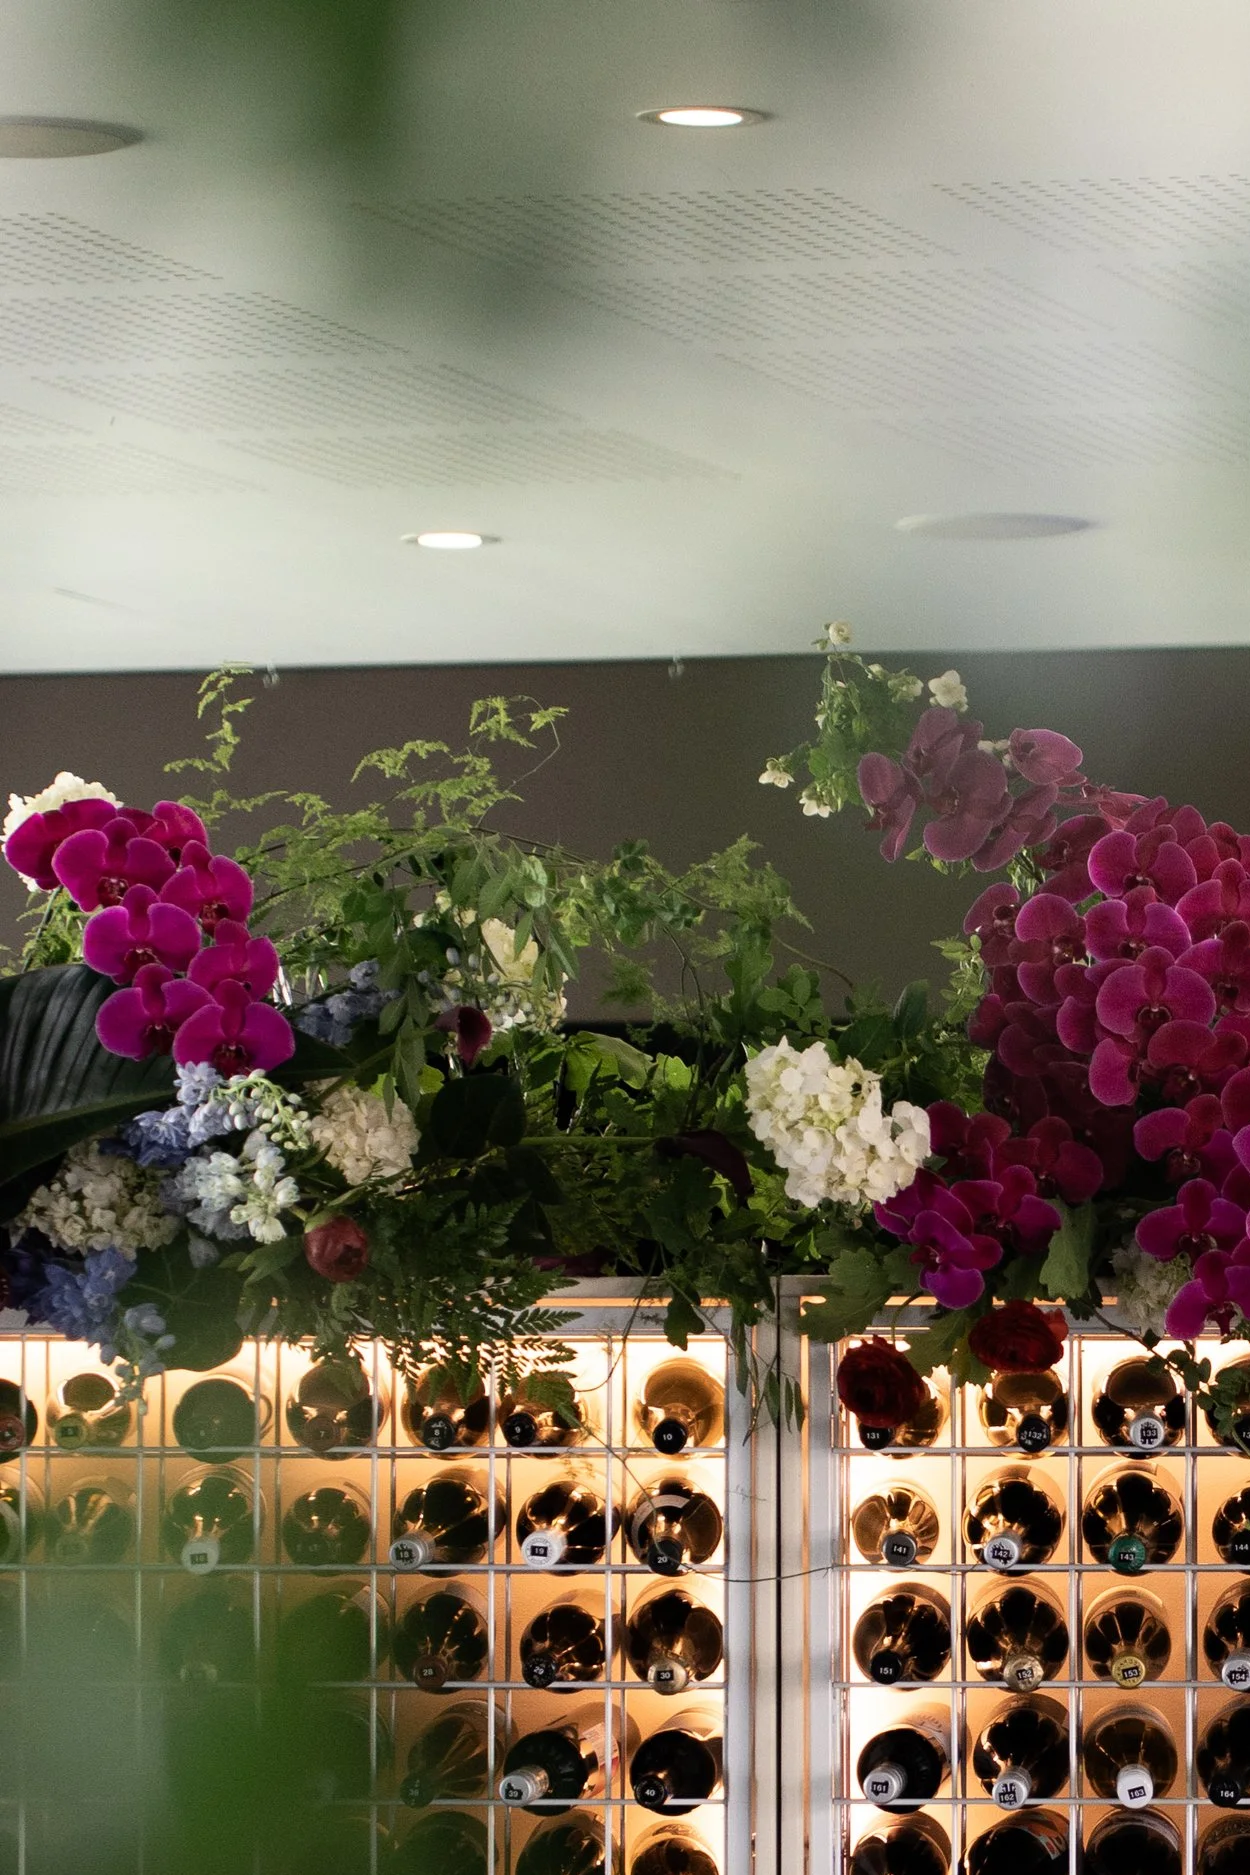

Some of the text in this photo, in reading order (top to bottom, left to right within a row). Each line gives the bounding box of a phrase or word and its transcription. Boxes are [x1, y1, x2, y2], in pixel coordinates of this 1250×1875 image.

[1028, 1431, 1042, 1440] 132
[1142, 1429, 1157, 1437] 133
[894, 1545, 906, 1554] 141
[994, 1550, 1008, 1558] 142
[1120, 1553, 1134, 1561] 143
[657, 1555, 668, 1563] 20
[423, 1668, 433, 1676] 28
[533, 1665, 544, 1675] 29
[880, 1667, 893, 1675] 151
[1124, 1669, 1138, 1678] 153
[1018, 1670, 1032, 1679] 152
[873, 1784, 886, 1792] 161
[1000, 1793, 1014, 1801] 162
[1130, 1789, 1145, 1798] 163
[1221, 1790, 1234, 1798] 164
